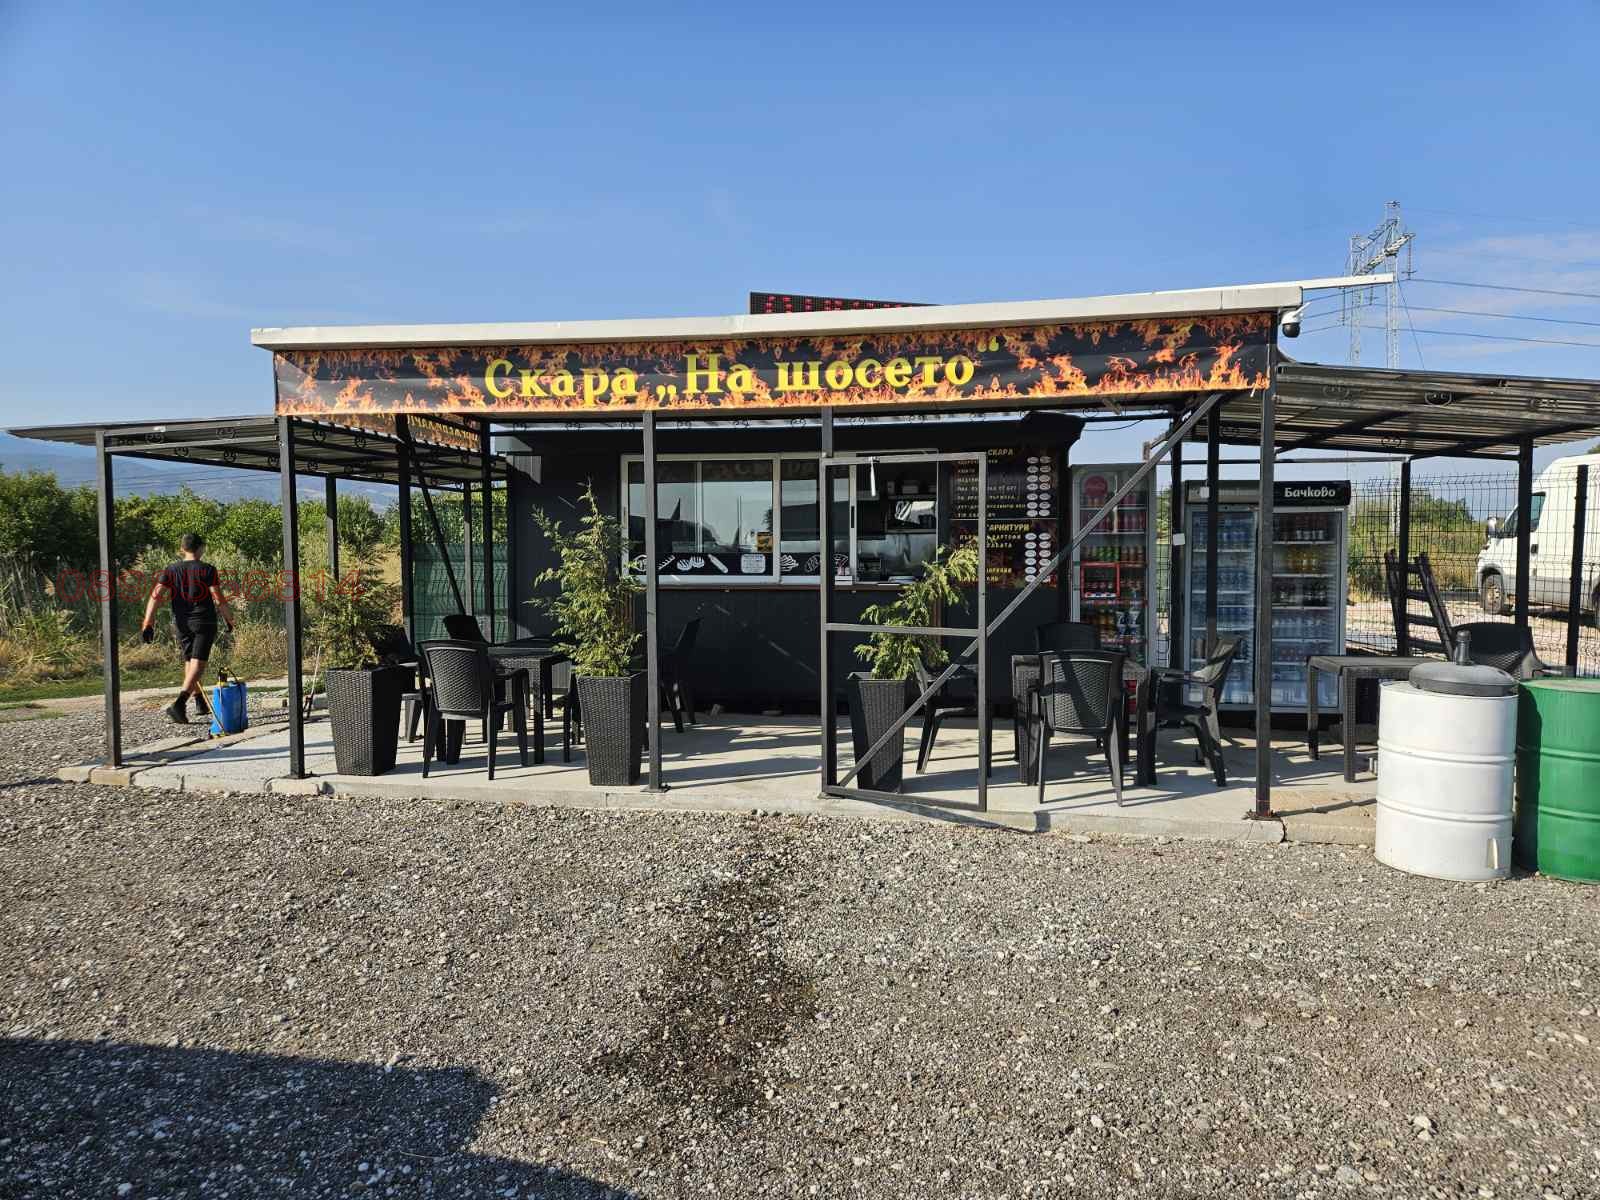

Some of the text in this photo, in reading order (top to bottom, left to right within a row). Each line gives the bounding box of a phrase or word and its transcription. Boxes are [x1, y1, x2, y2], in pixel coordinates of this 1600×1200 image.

[485, 359, 638, 407] Скара
[987, 448, 1014, 456] СКАРА
[1284, 486, 1336, 498] Бачково
[986, 523, 1030, 532] АРНИТУРИ
